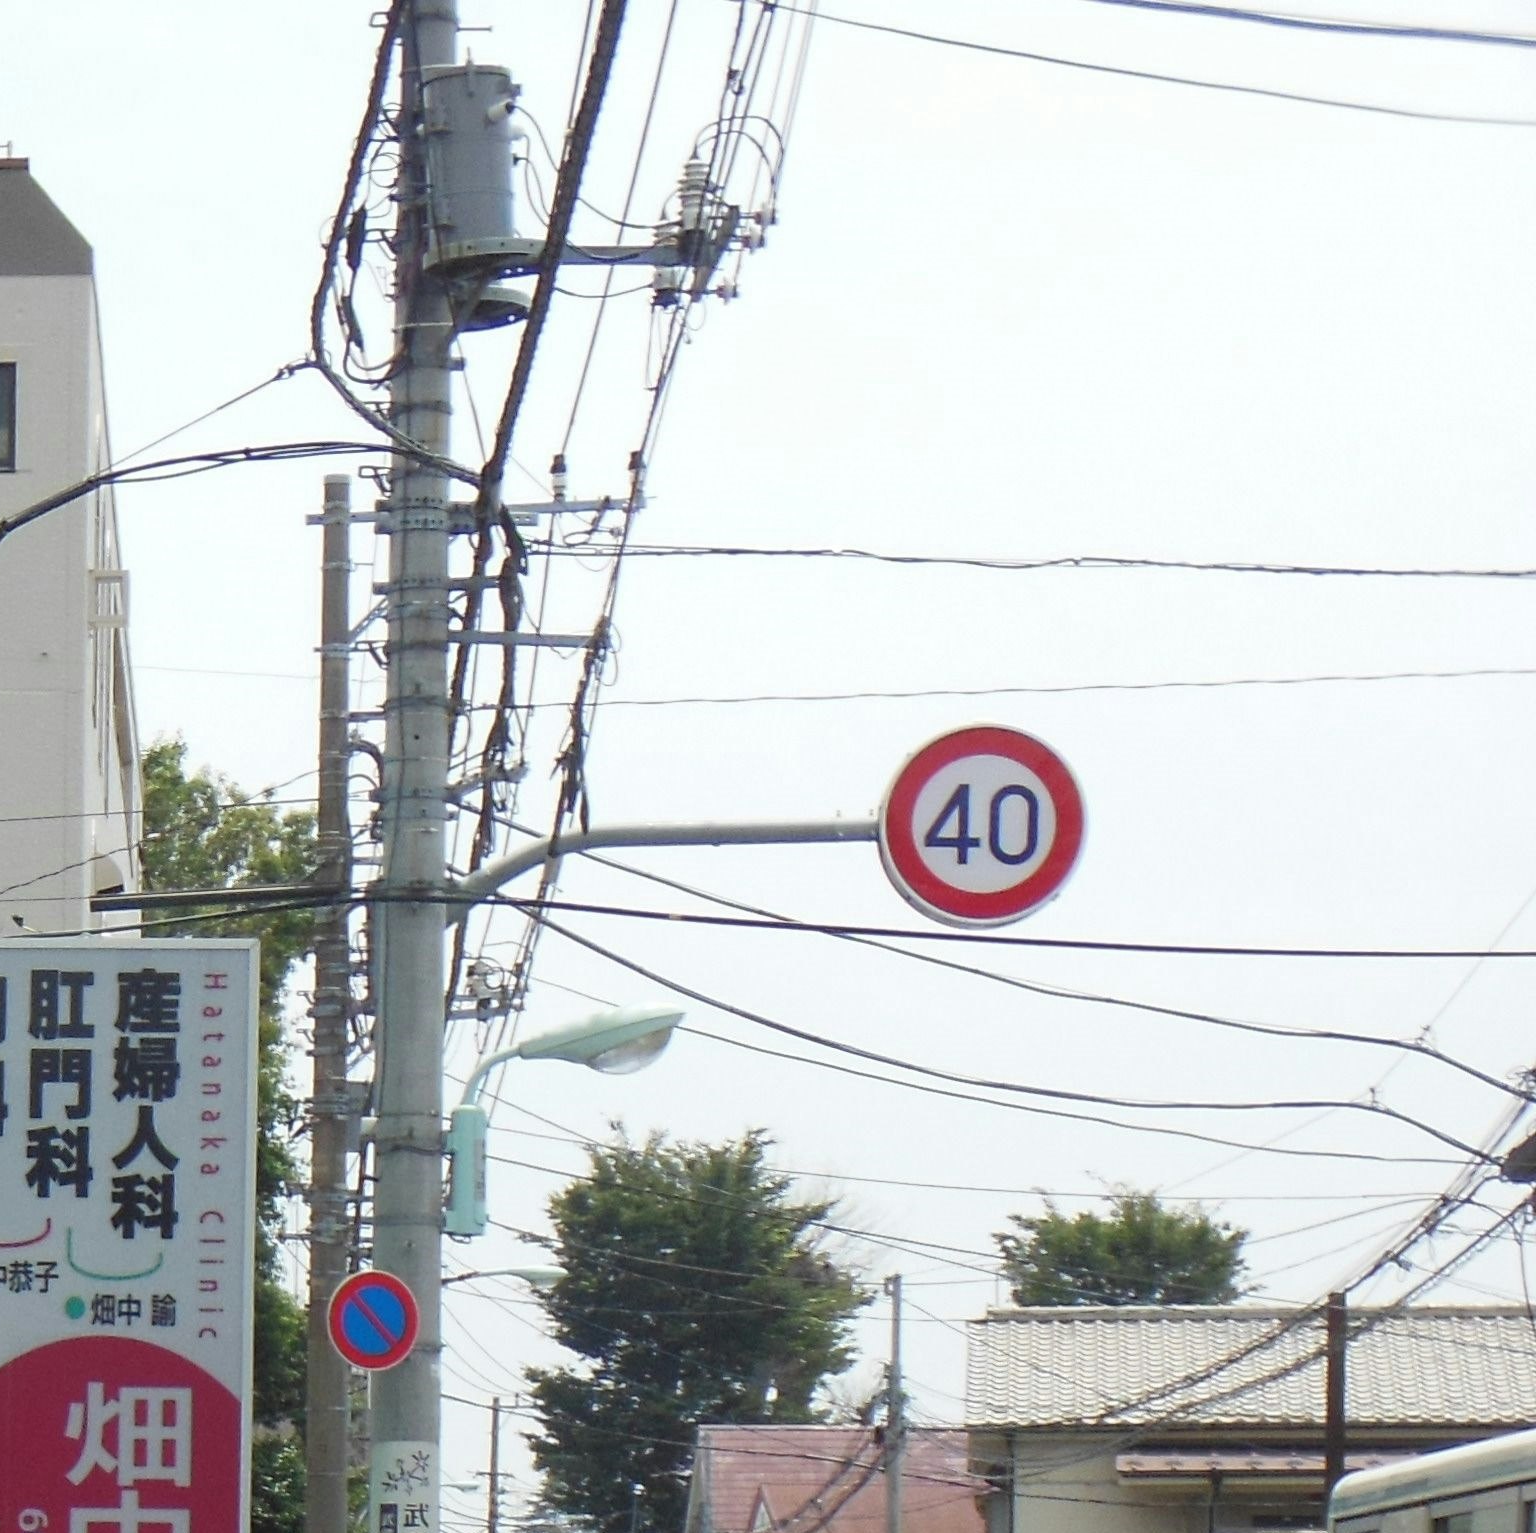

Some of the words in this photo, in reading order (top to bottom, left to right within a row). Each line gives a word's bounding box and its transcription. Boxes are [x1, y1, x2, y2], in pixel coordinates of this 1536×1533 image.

[925, 784, 1038, 865] 40
[26, 969, 95, 1198] 肛門科
[111, 969, 181, 1239] 産婦人科
[200, 973, 228, 1175] Hatanaka
[90, 1292, 142, 1327] 畑中
[198, 1210, 225, 1339] Clinic
